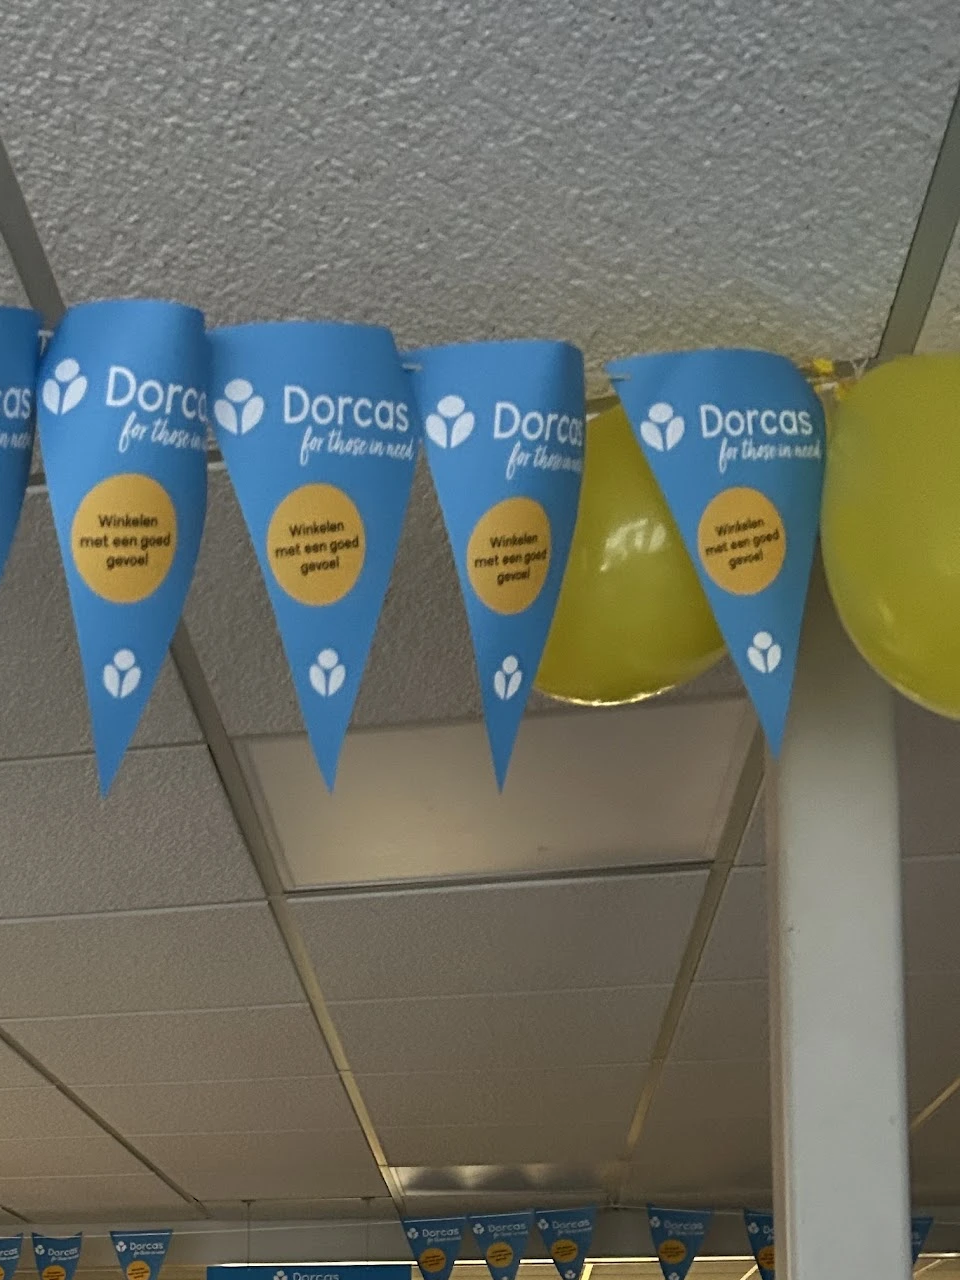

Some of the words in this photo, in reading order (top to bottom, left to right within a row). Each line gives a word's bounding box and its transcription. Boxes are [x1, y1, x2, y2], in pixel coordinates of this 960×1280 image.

[106, 365, 209, 423] Dorca
[283, 384, 410, 433] Dorcas
[700, 404, 814, 439] Dorcas
[119, 410, 149, 454] for
[151, 417, 189, 449] those
[299, 425, 325, 467] for
[326, 428, 369, 457] those
[369, 435, 385, 456] in
[386, 437, 415, 461] need
[719, 436, 740, 475] for
[741, 438, 777, 462] those
[505, 440, 533, 481] for
[98, 513, 159, 529] Winkelen
[288, 520, 345, 538] Winkelen
[80, 535, 109, 549] met
[112, 536, 138, 548] een
[140, 531, 171, 551] goed
[275, 544, 301, 558] met
[304, 542, 328, 554] een
[329, 535, 359, 554] goed
[489, 533, 539, 549] Winkelen
[105, 552, 148, 571] gevoel
[300, 556, 340, 576] gevoel
[474, 555, 500, 568] met
[502, 554, 523, 565] een
[524, 548, 547, 566] goed
[496, 567, 530, 586] gevoel
[422, 1228, 460, 1238] Dorcas
[130, 1242, 165, 1251] Dorcas
